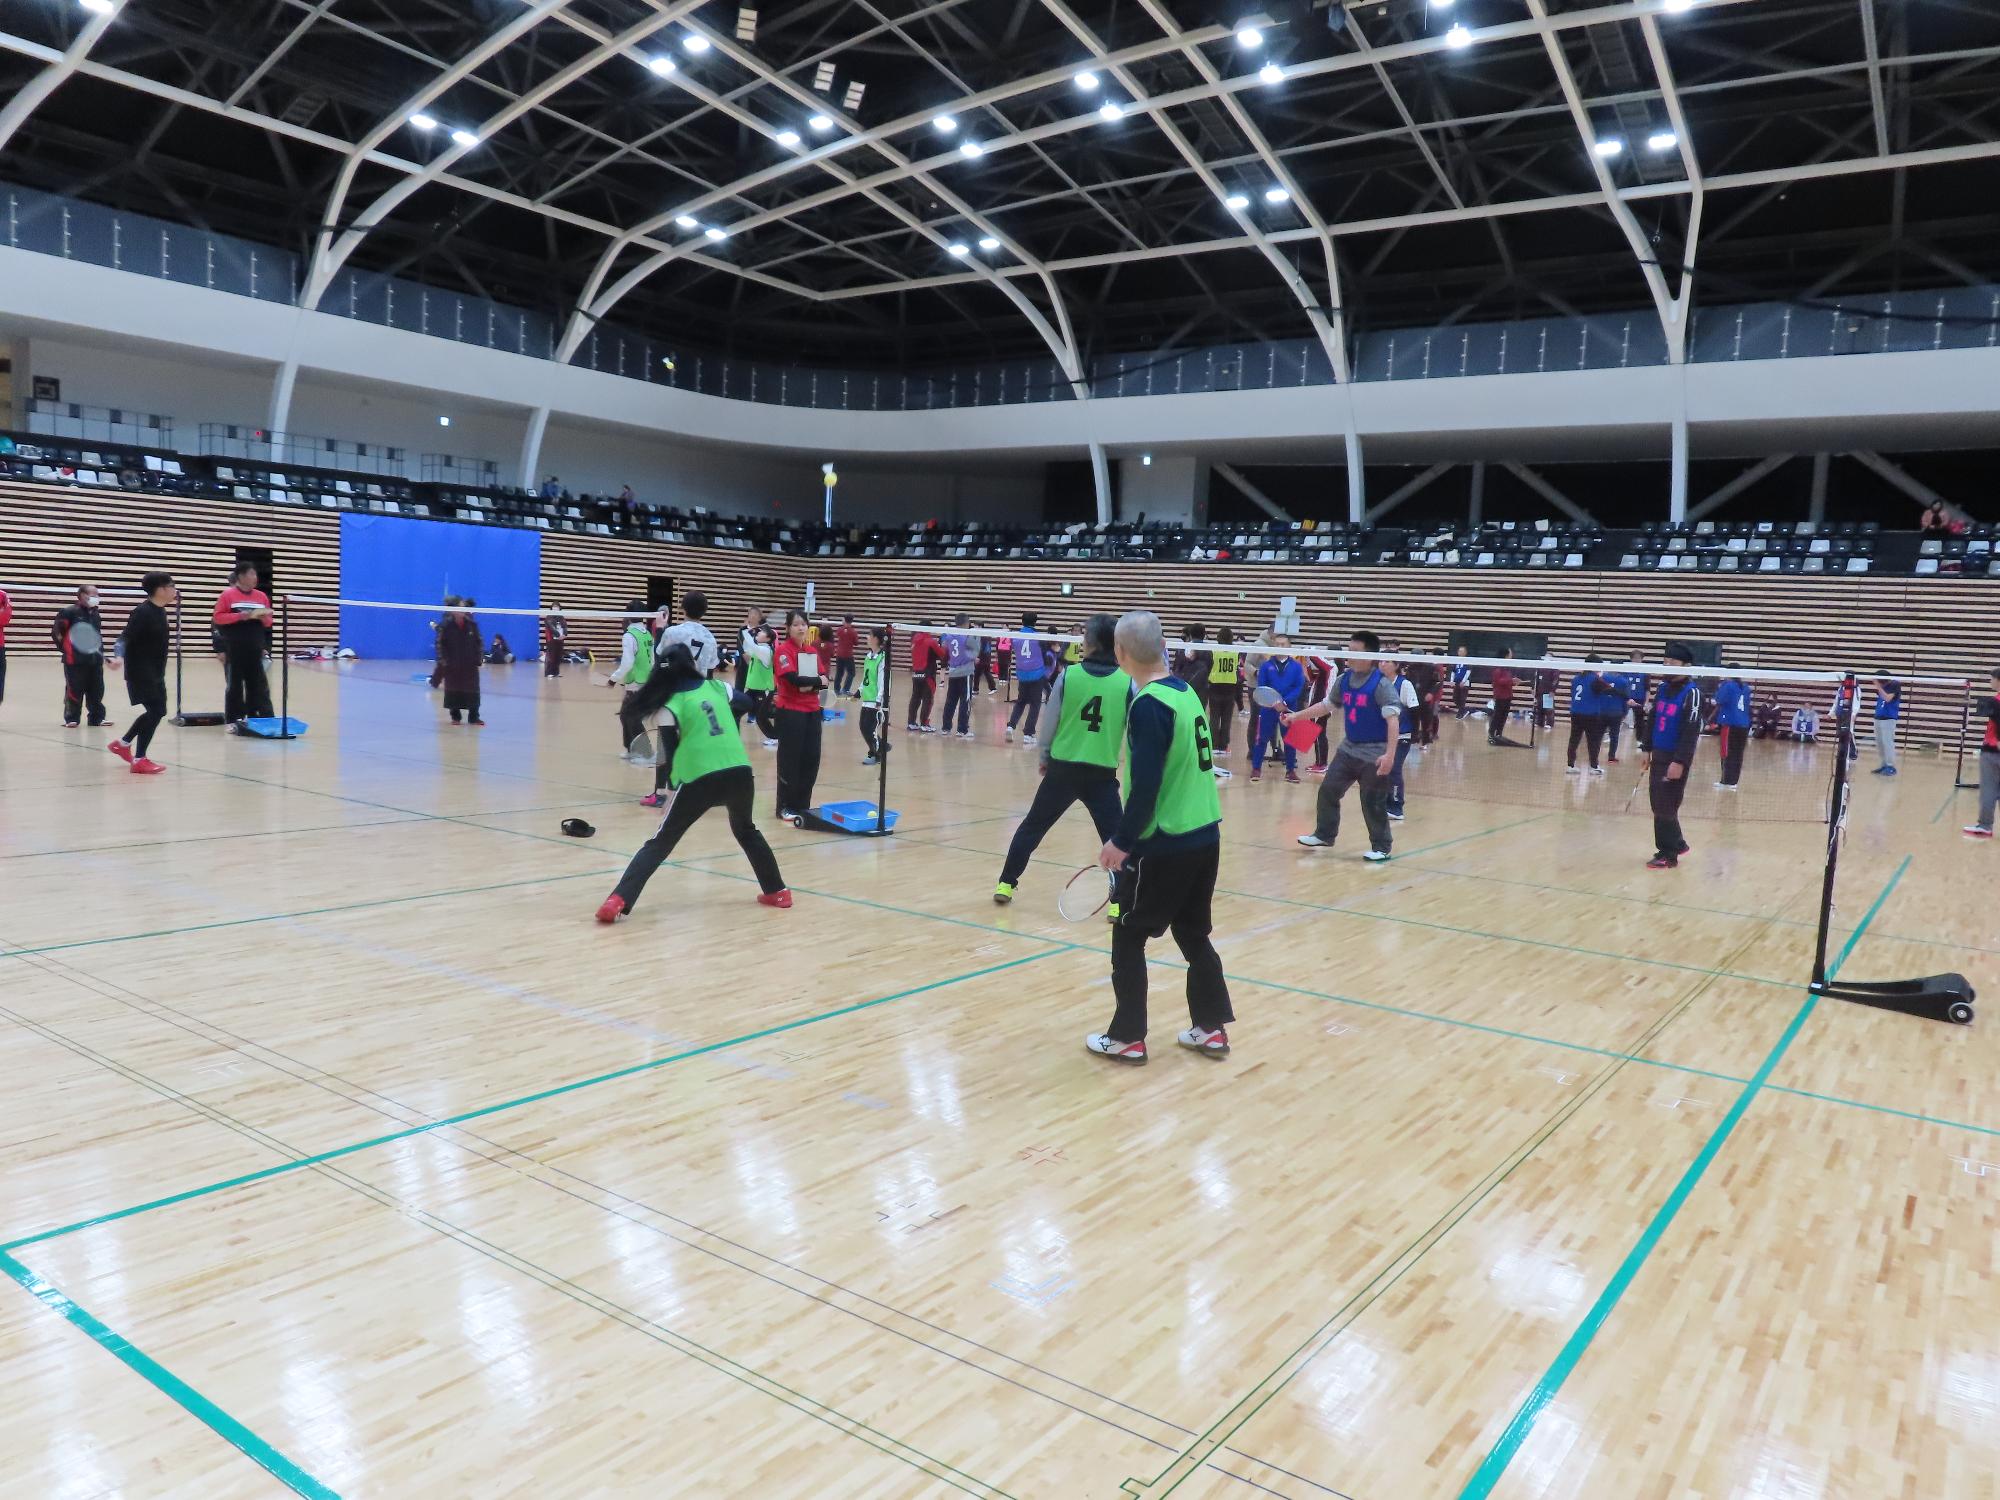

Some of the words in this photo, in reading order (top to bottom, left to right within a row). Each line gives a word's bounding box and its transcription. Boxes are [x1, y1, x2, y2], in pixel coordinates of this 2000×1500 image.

[690, 638, 704, 661] 7
[951, 639, 959, 658] 3
[1020, 639, 1031, 658] 4
[1218, 657, 1234, 673] 106
[1574, 684, 1583, 701] 2
[1737, 694, 1745, 712] 4
[701, 700, 725, 737] 1
[1081, 695, 1103, 732] 4
[1194, 715, 1213, 773] 6
